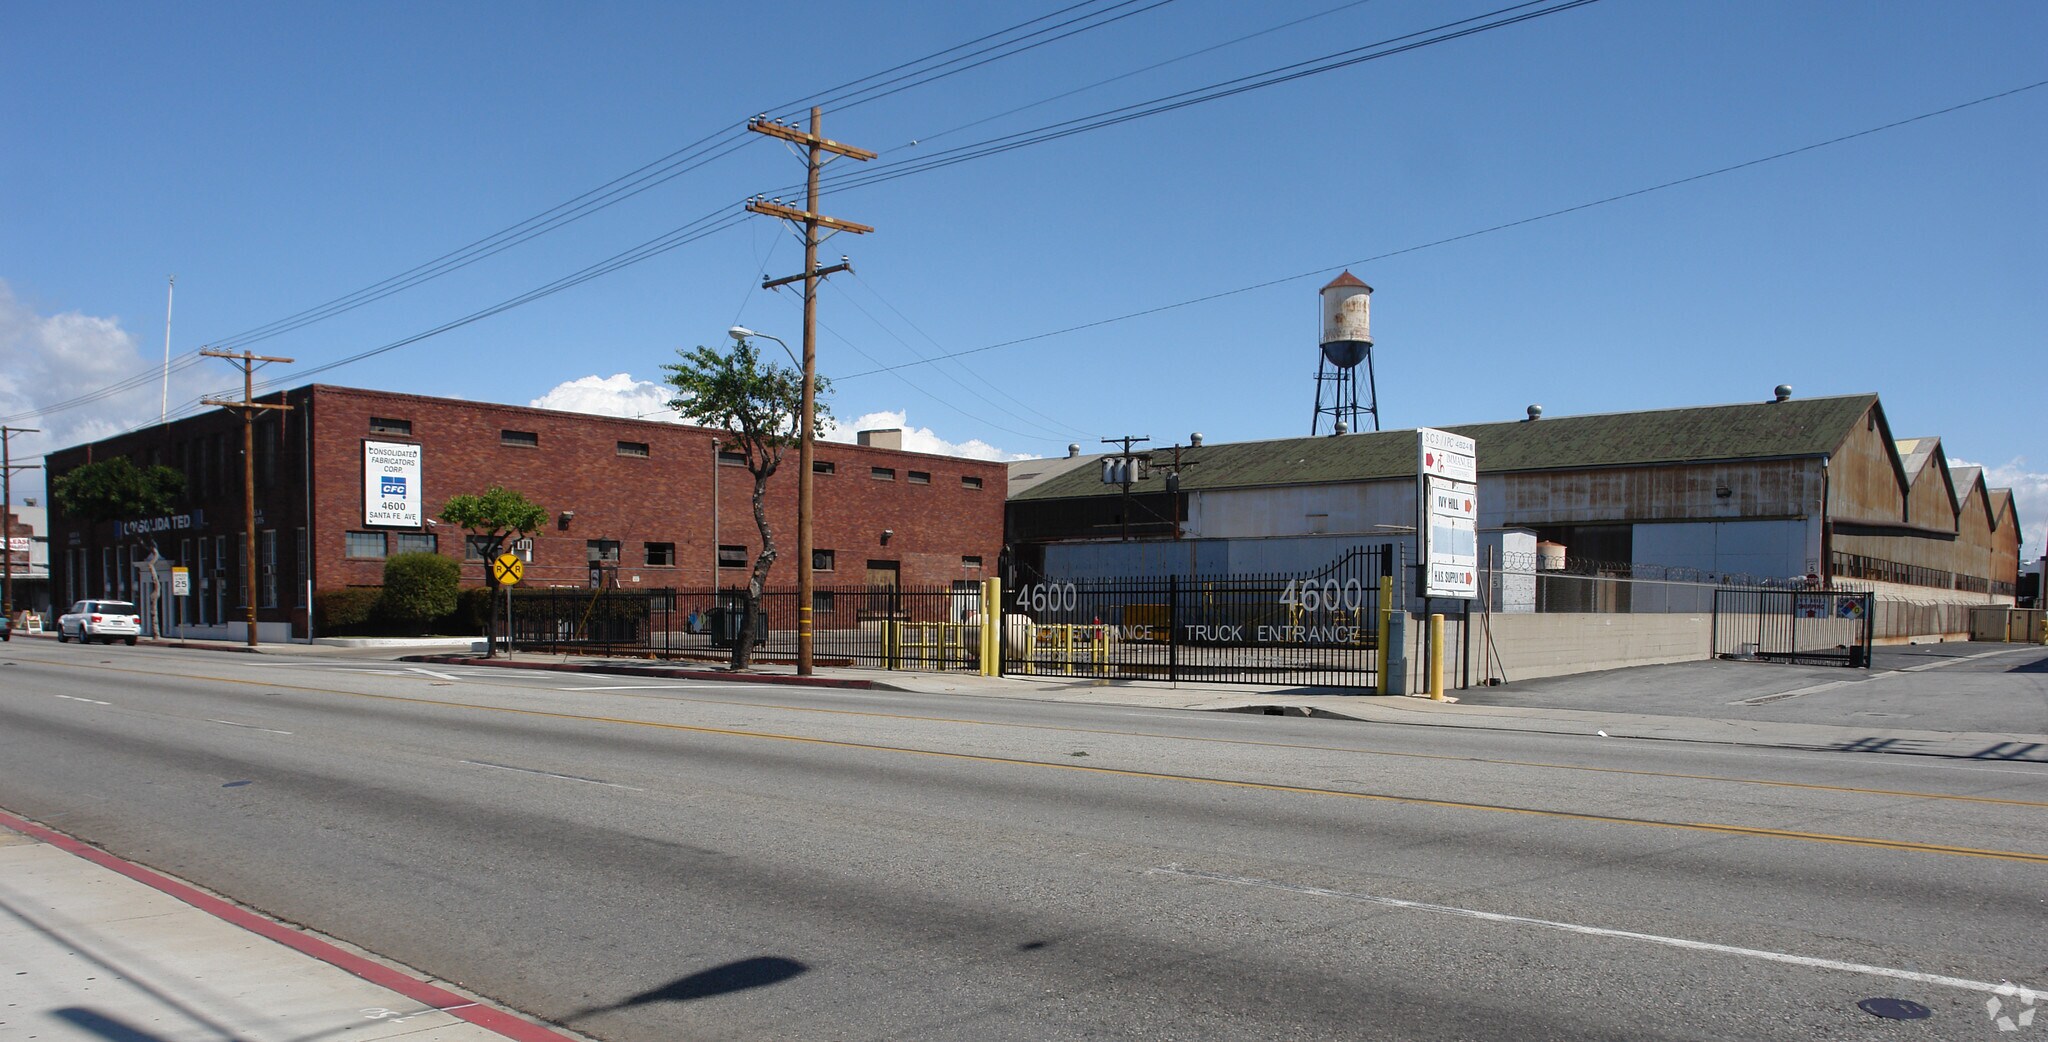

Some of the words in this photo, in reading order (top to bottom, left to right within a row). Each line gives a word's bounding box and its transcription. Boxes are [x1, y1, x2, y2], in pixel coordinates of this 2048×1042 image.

[368, 447, 417, 458] CONSOLIDATED
[371, 457, 415, 466] FABRICATORS
[383, 485, 405, 494] CFC
[381, 501, 406, 511] 4600
[1438, 495, 1447, 508] IVY
[1448, 497, 1459, 510] HILL
[369, 511, 391, 519] SANTA
[392, 512, 401, 520] FE
[497, 565, 502, 573] R
[515, 565, 521, 573] R
[1445, 571, 1459, 584] SUPPLY
[175, 580, 187, 588] 25
[1016, 583, 1077, 612] 4600
[1279, 578, 1362, 612] 4600
[1072, 624, 1154, 641] ENTRANCE
[1185, 625, 1243, 642] TRUCK
[1257, 625, 1361, 643] ENTRANCE
